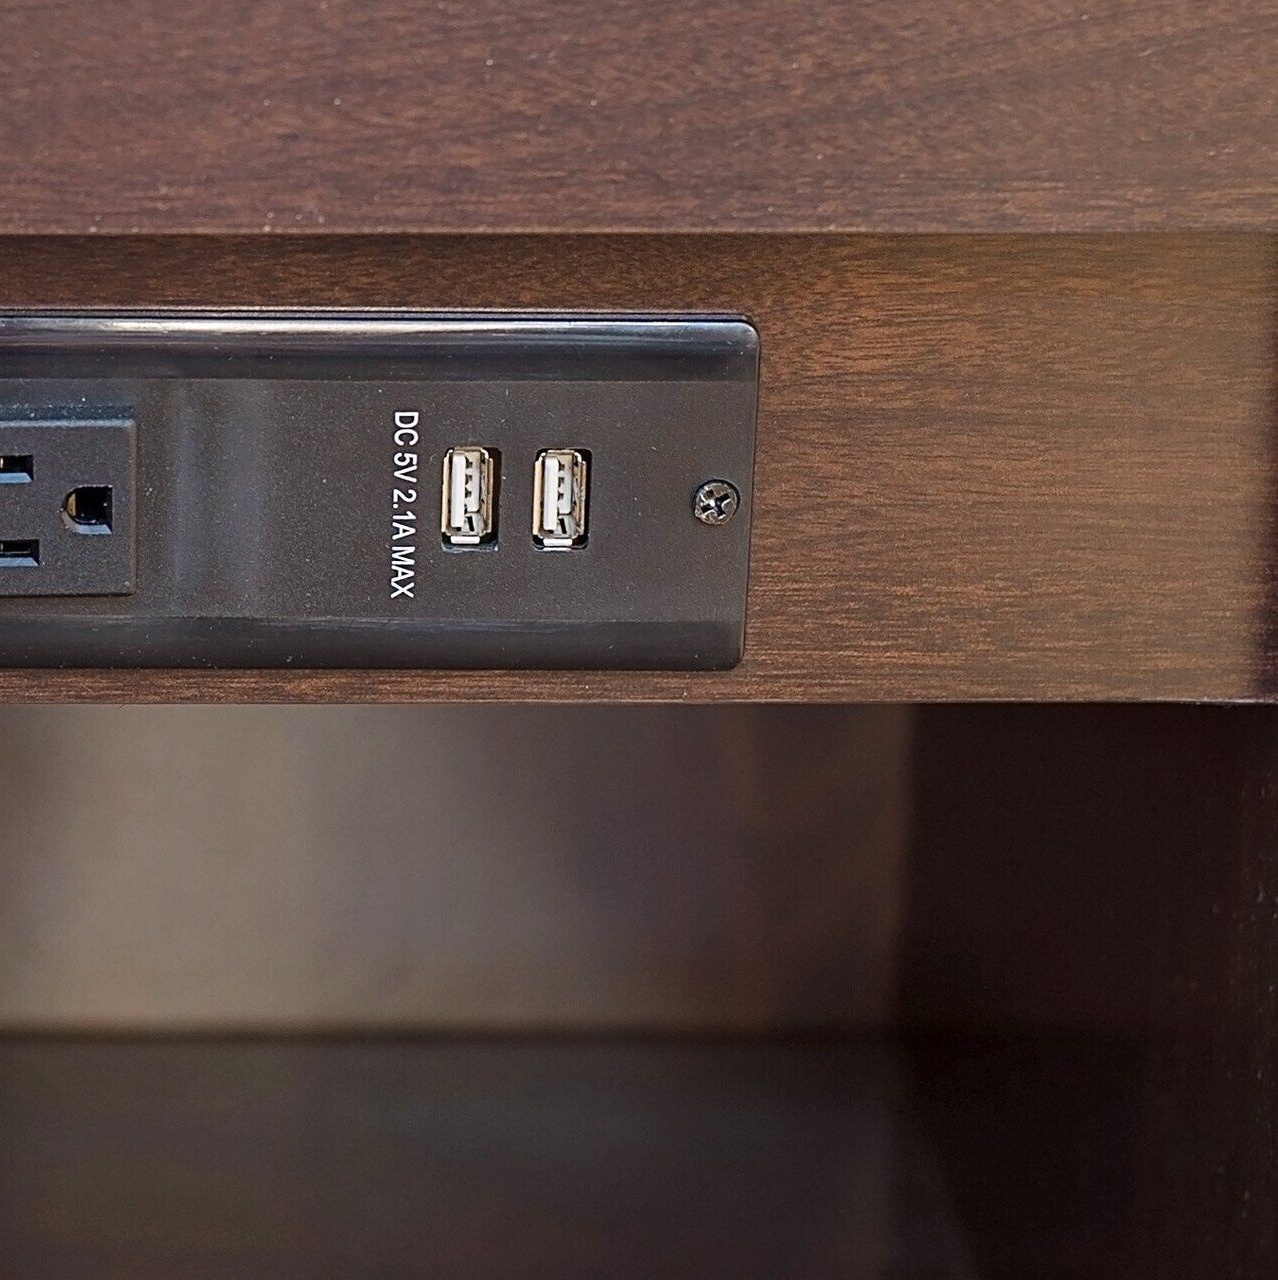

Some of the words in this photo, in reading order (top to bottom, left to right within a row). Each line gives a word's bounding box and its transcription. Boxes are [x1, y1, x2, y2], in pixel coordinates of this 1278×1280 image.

[393, 411, 420, 446] DC
[393, 452, 418, 483] 5V
[391, 488, 417, 541] 2.1A
[390, 546, 416, 599] MAX
